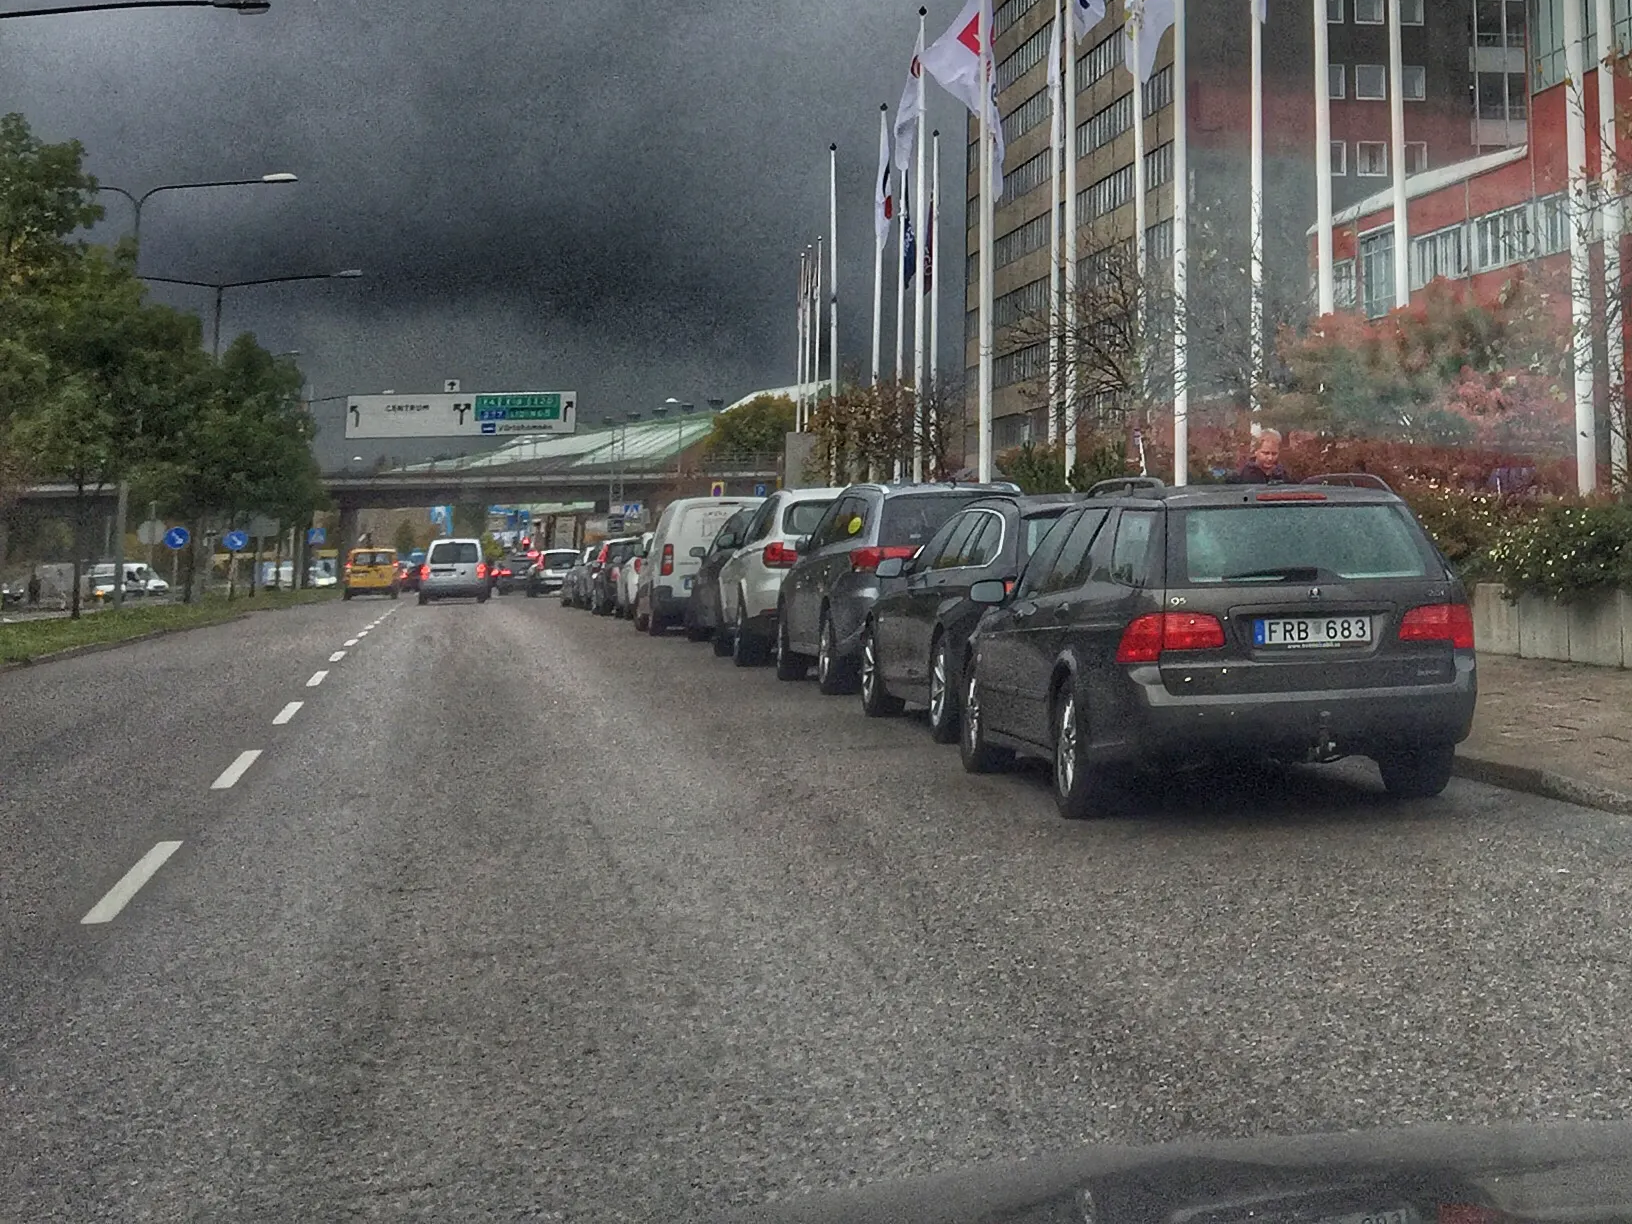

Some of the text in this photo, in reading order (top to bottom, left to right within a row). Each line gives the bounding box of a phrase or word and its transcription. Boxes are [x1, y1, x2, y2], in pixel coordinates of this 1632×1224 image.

[385, 404, 430, 412] CENTRUM
[1268, 619, 1366, 642] FRB 683
